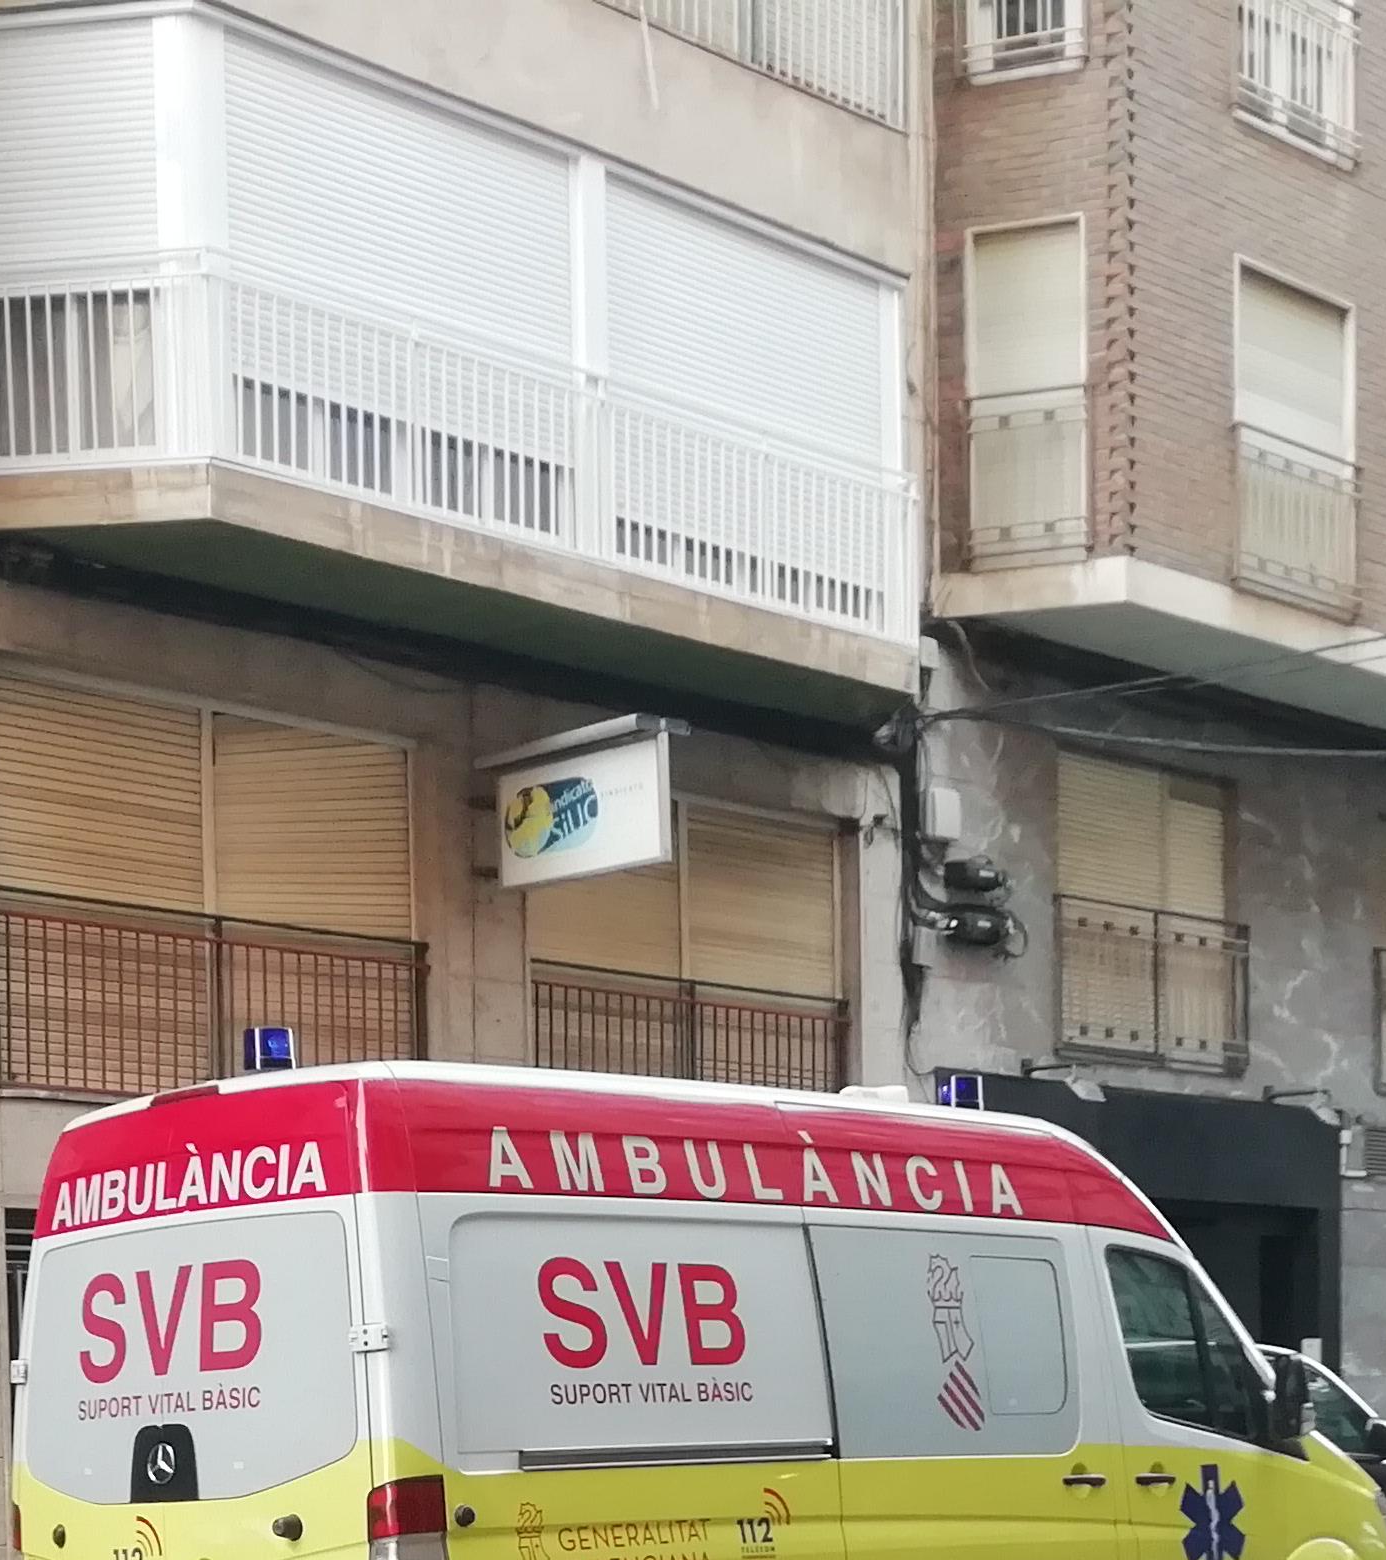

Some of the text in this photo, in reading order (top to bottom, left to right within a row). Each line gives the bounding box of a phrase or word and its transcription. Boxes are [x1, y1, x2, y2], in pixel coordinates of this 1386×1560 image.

[51, 1142, 328, 1232] AMBULÀNCIA
[488, 1126, 1025, 1216] AMBULÀNCIA
[79, 1258, 262, 1385] SVB
[537, 1255, 746, 1369] SVB
[77, 1383, 261, 1421] SUPORT VITAL BÀSIC
[549, 1376, 754, 1406] SUPORT VITAL BÀSIC
[558, 1518, 712, 1551] GENERALITAT
[736, 1517, 774, 1544] 112
